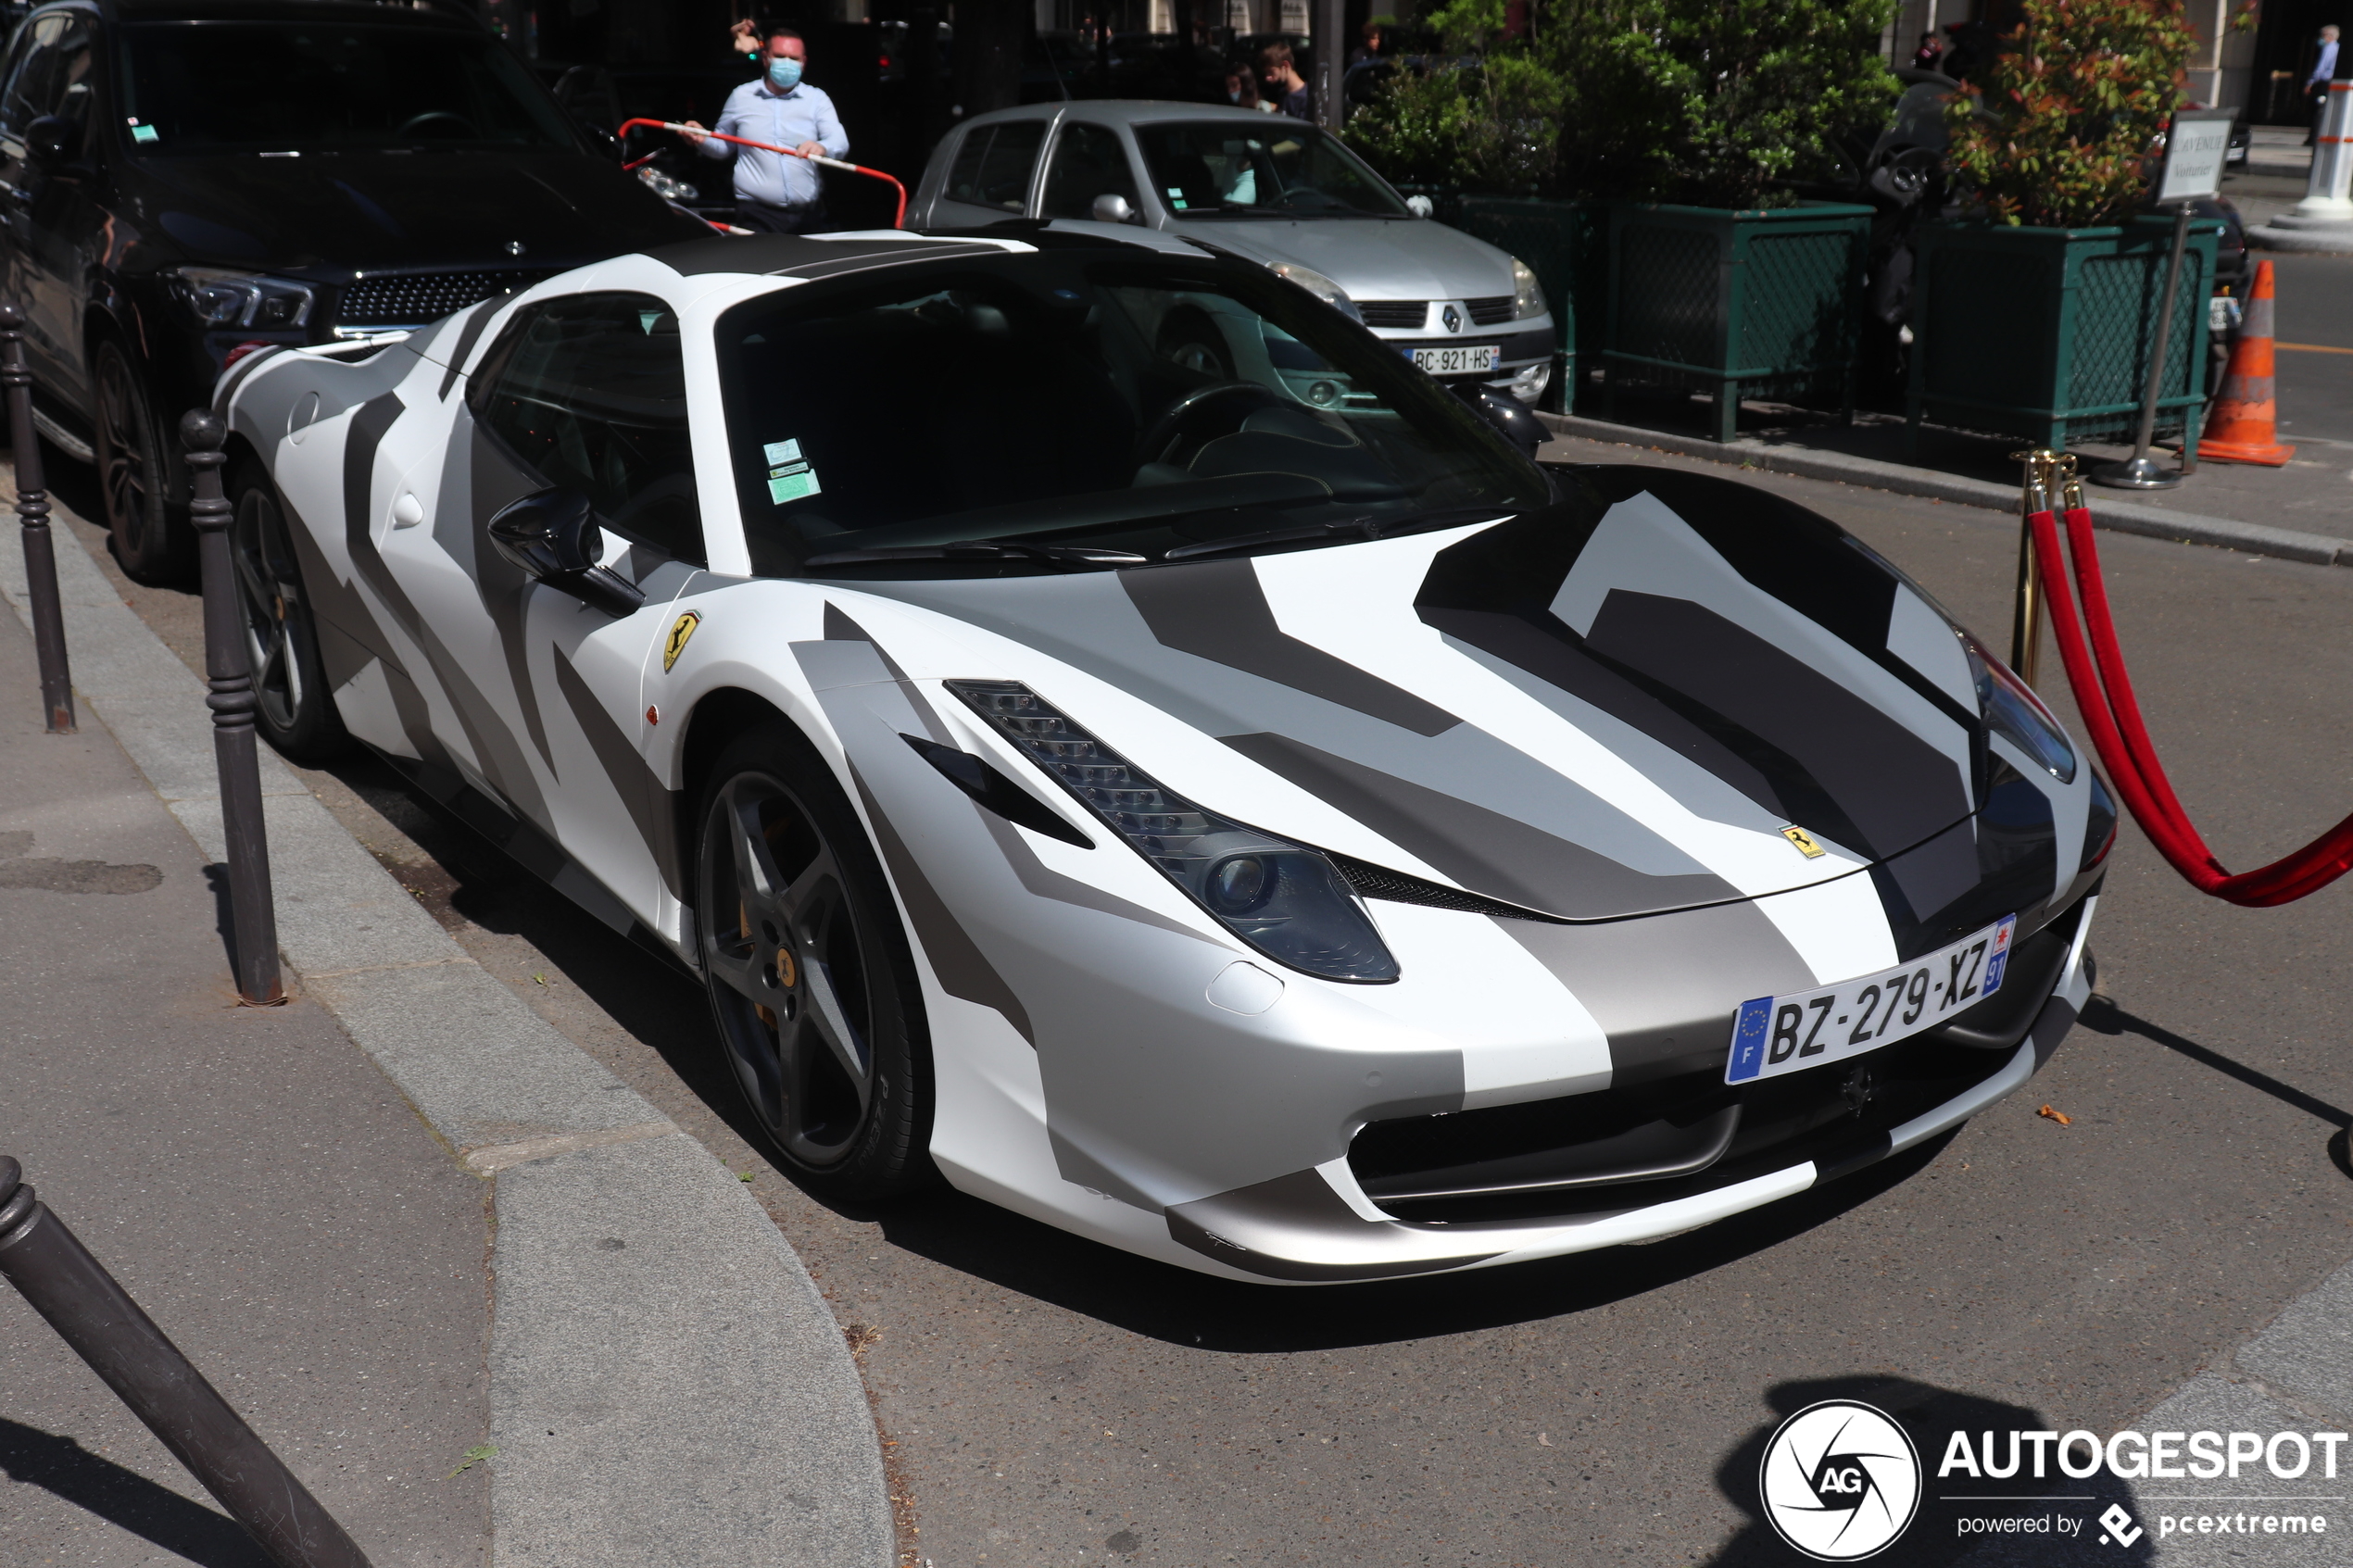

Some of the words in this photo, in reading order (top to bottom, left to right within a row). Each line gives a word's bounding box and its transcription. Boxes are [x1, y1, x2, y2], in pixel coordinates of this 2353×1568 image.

[2173, 135, 2224, 152] L'AVENUE
[2175, 161, 2212, 177] Voiturier
[1416, 349, 1490, 370] BC-921-HS
[1985, 956, 2004, 986] 91
[1768, 938, 1989, 1065] BZ-279-XZ
[1742, 1046, 1755, 1065] F
